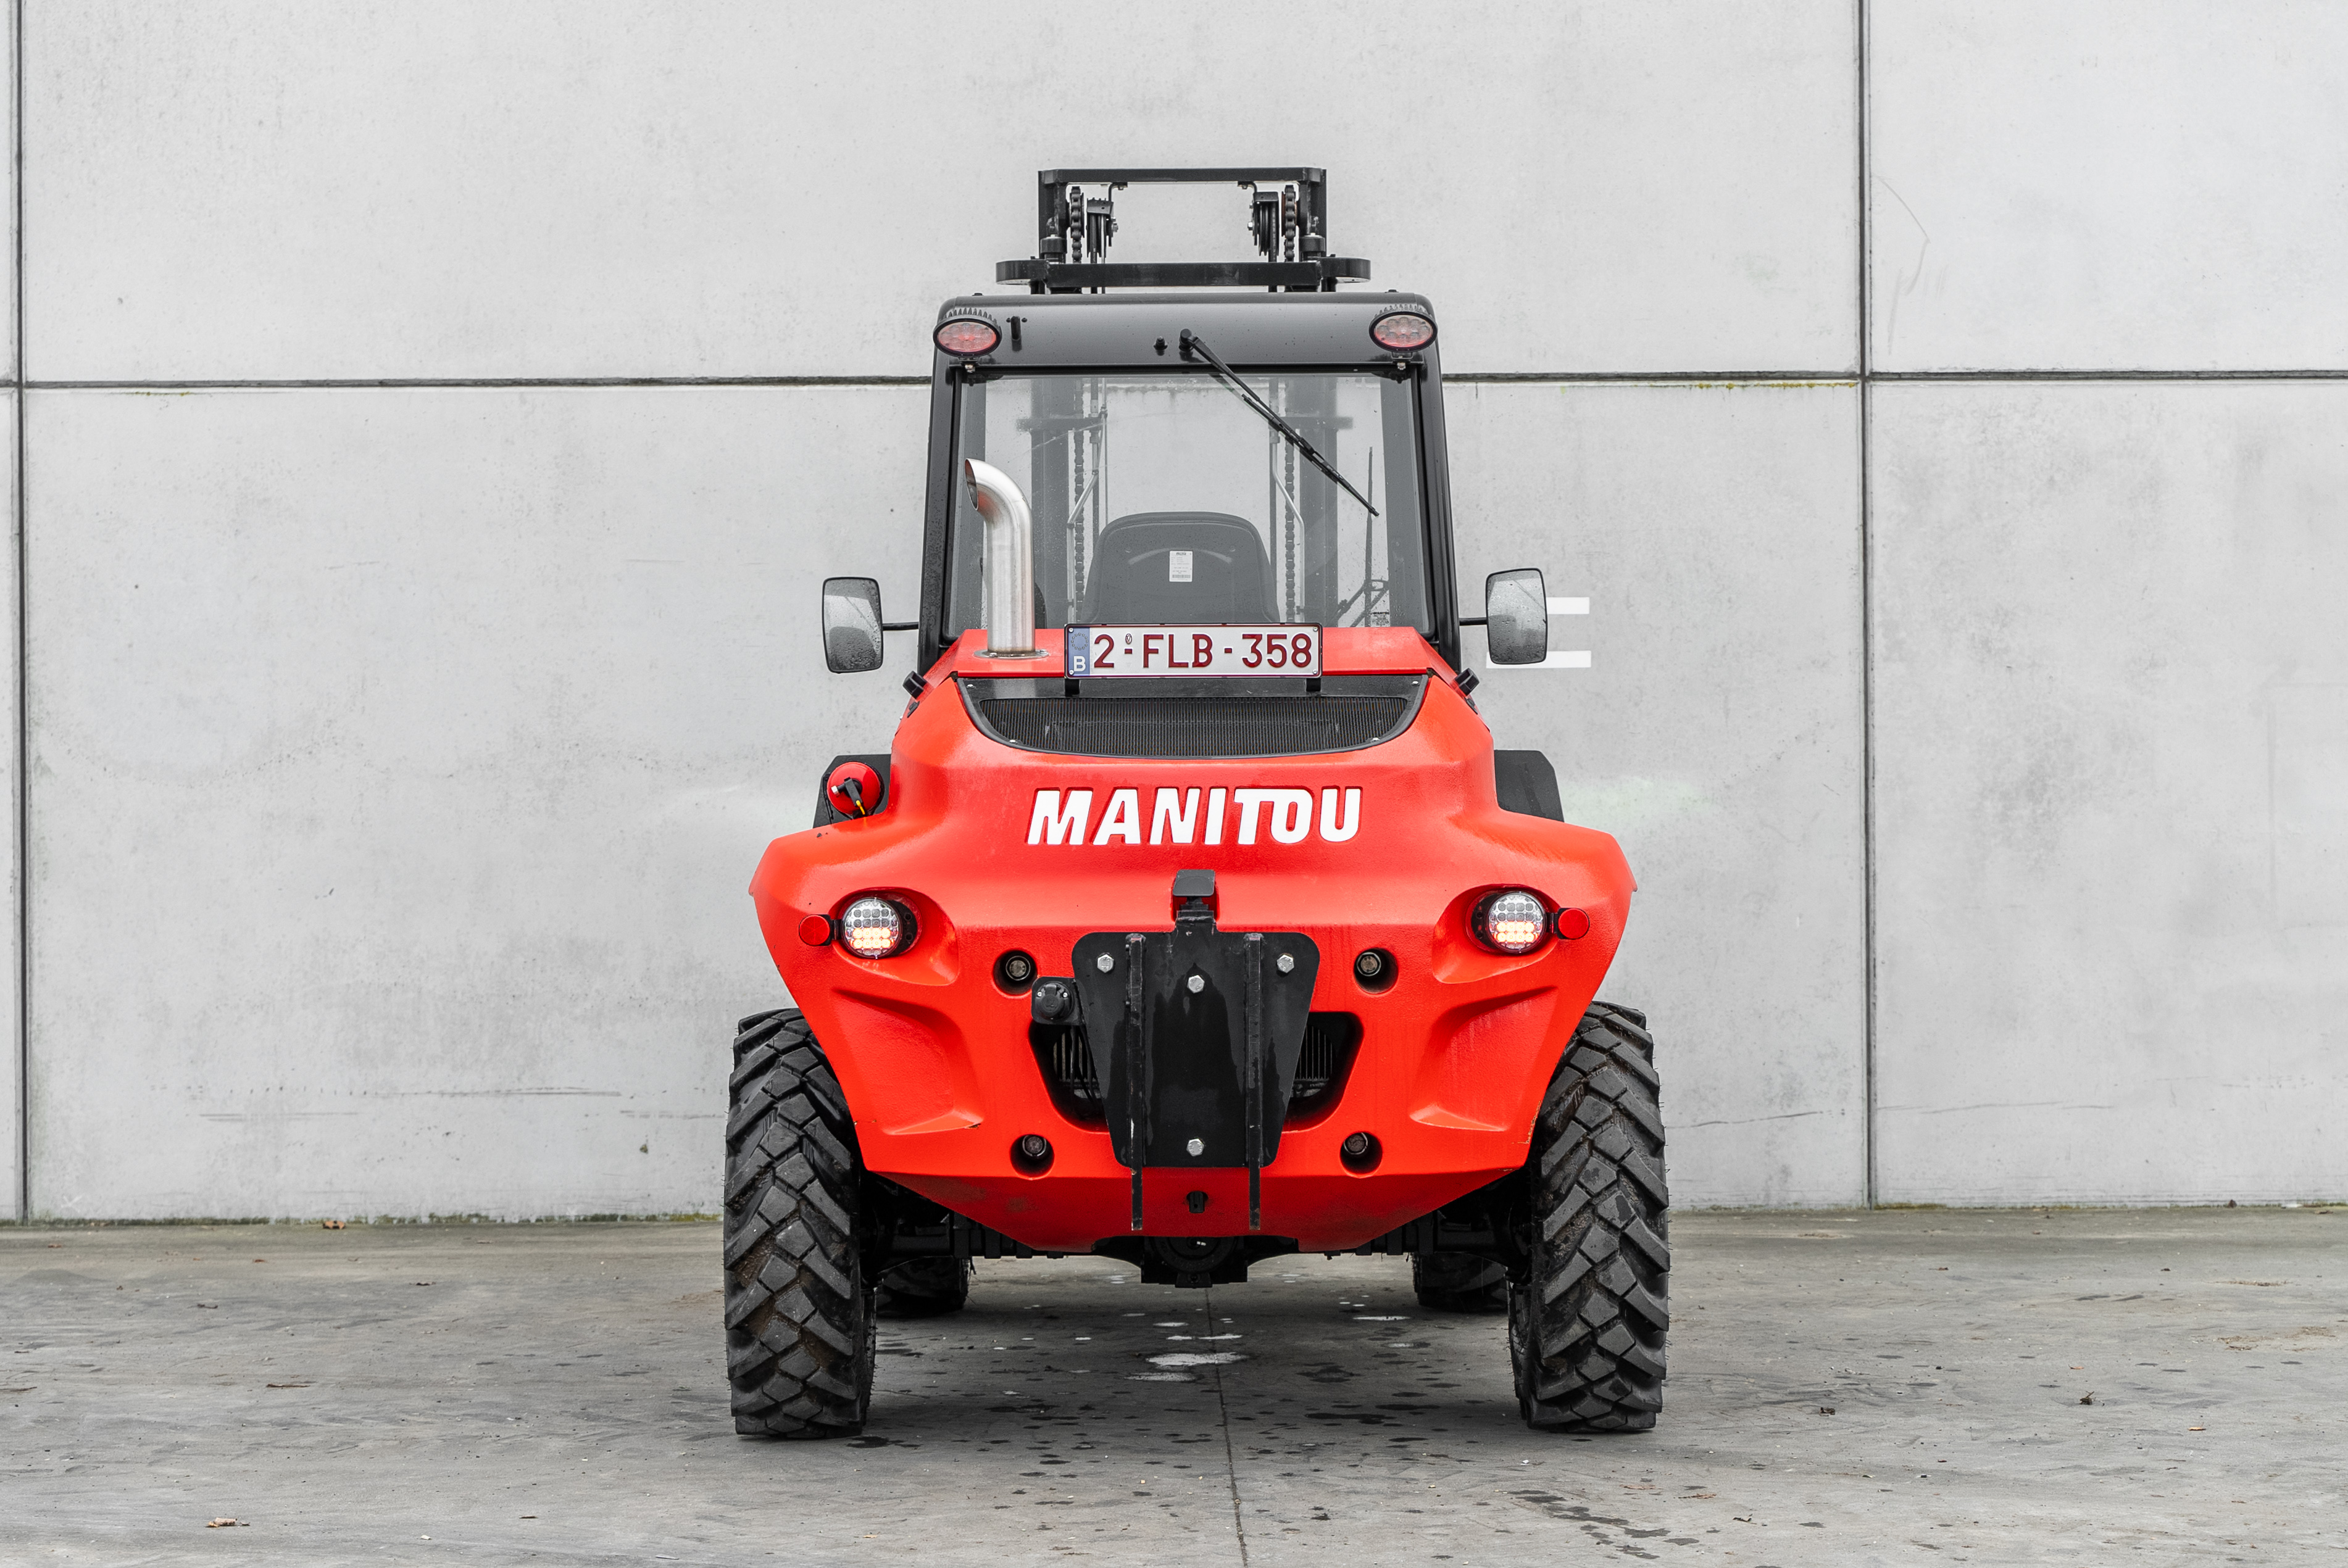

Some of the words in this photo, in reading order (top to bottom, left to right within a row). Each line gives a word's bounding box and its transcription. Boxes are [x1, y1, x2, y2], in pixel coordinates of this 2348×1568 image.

[1073, 655, 1086, 672] B
[1094, 633, 1312, 668] 2-FLB-358
[1026, 787, 1362, 845] MANITOU
